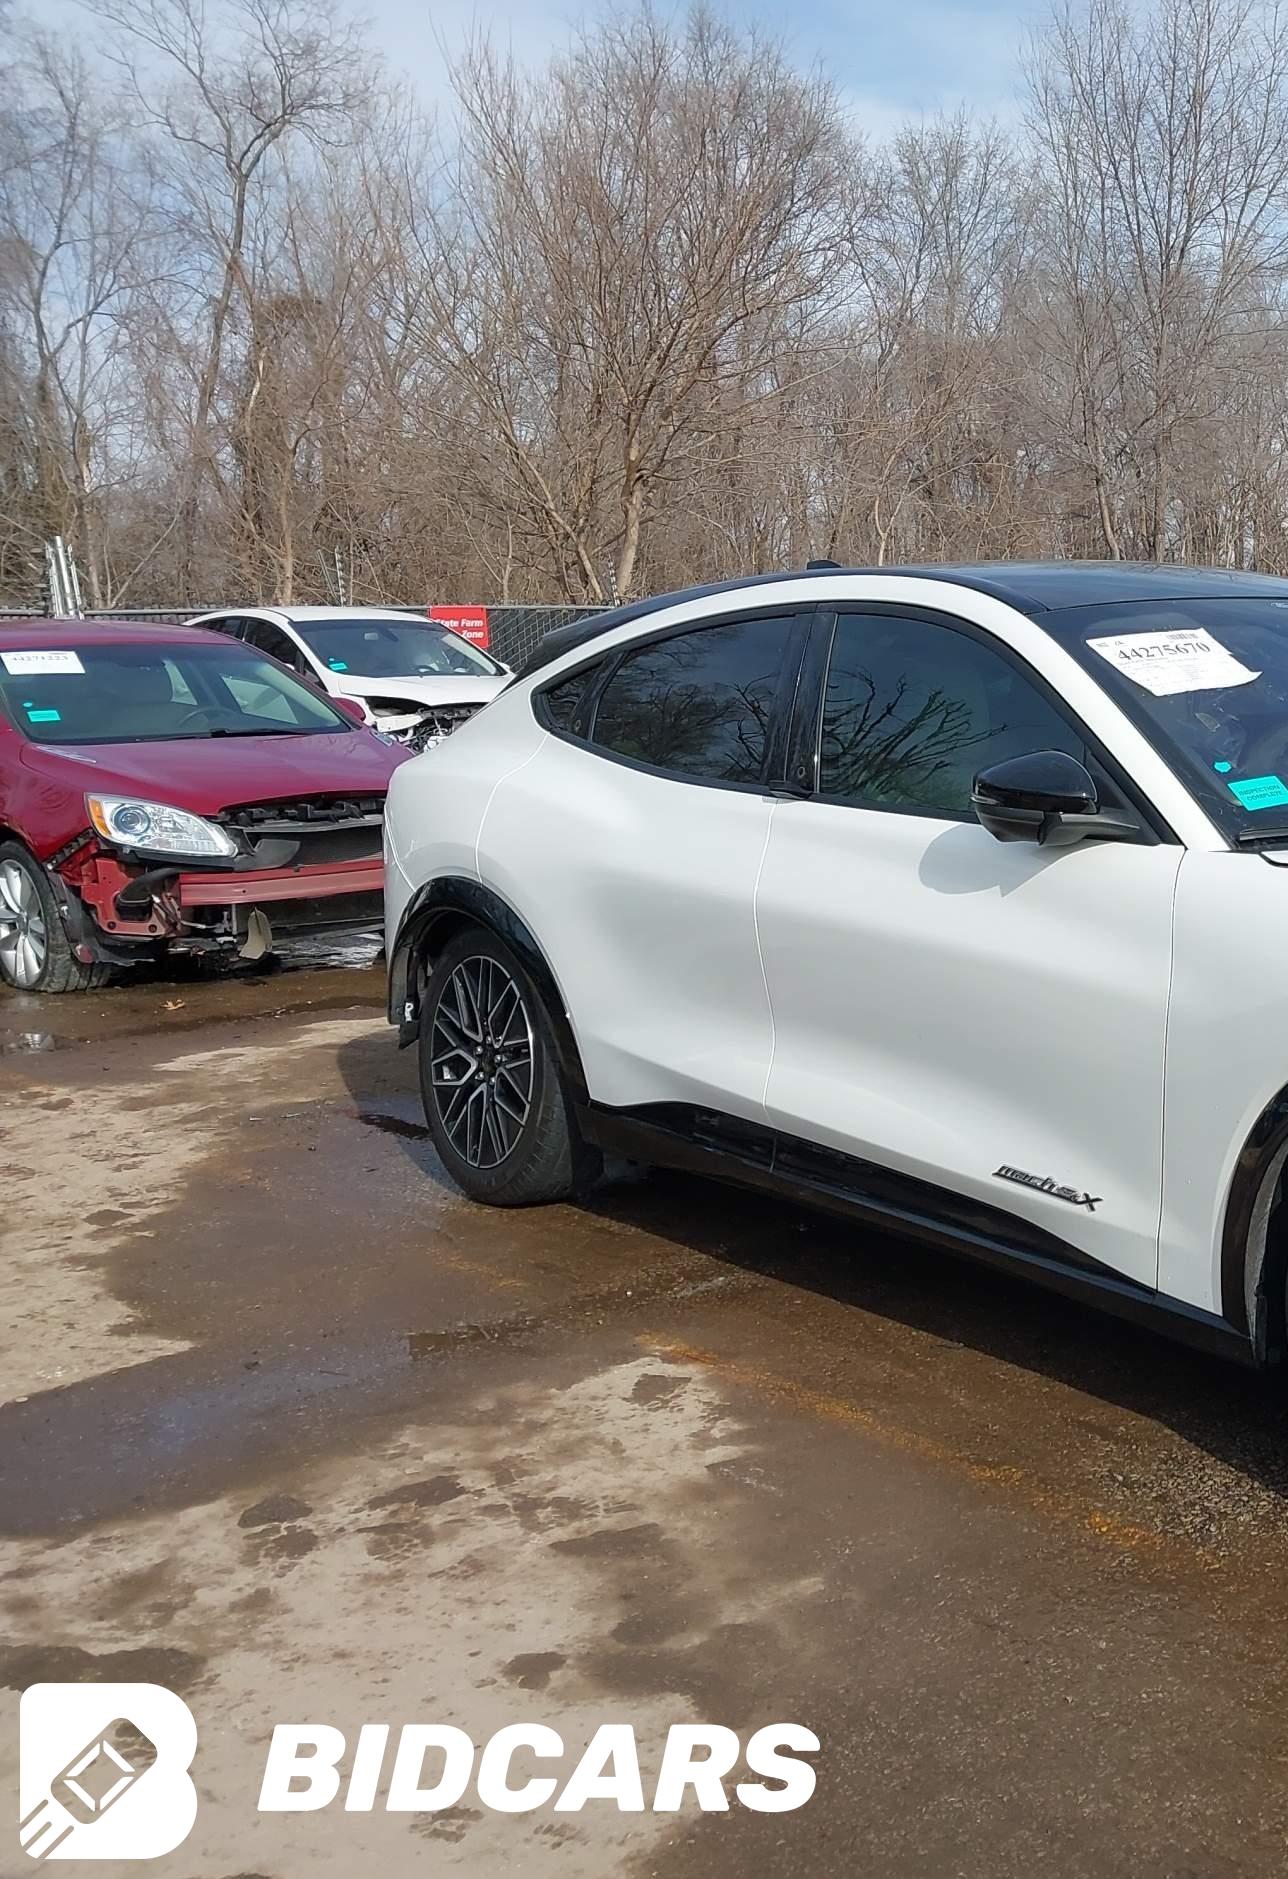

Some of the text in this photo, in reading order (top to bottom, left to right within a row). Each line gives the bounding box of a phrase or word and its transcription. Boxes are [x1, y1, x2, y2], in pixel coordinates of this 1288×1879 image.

[461, 619, 483, 627] Farm
[461, 630, 484, 638] Zone
[1118, 642, 1212, 661] 44275670
[1238, 785, 1280, 796] INSPECTION
